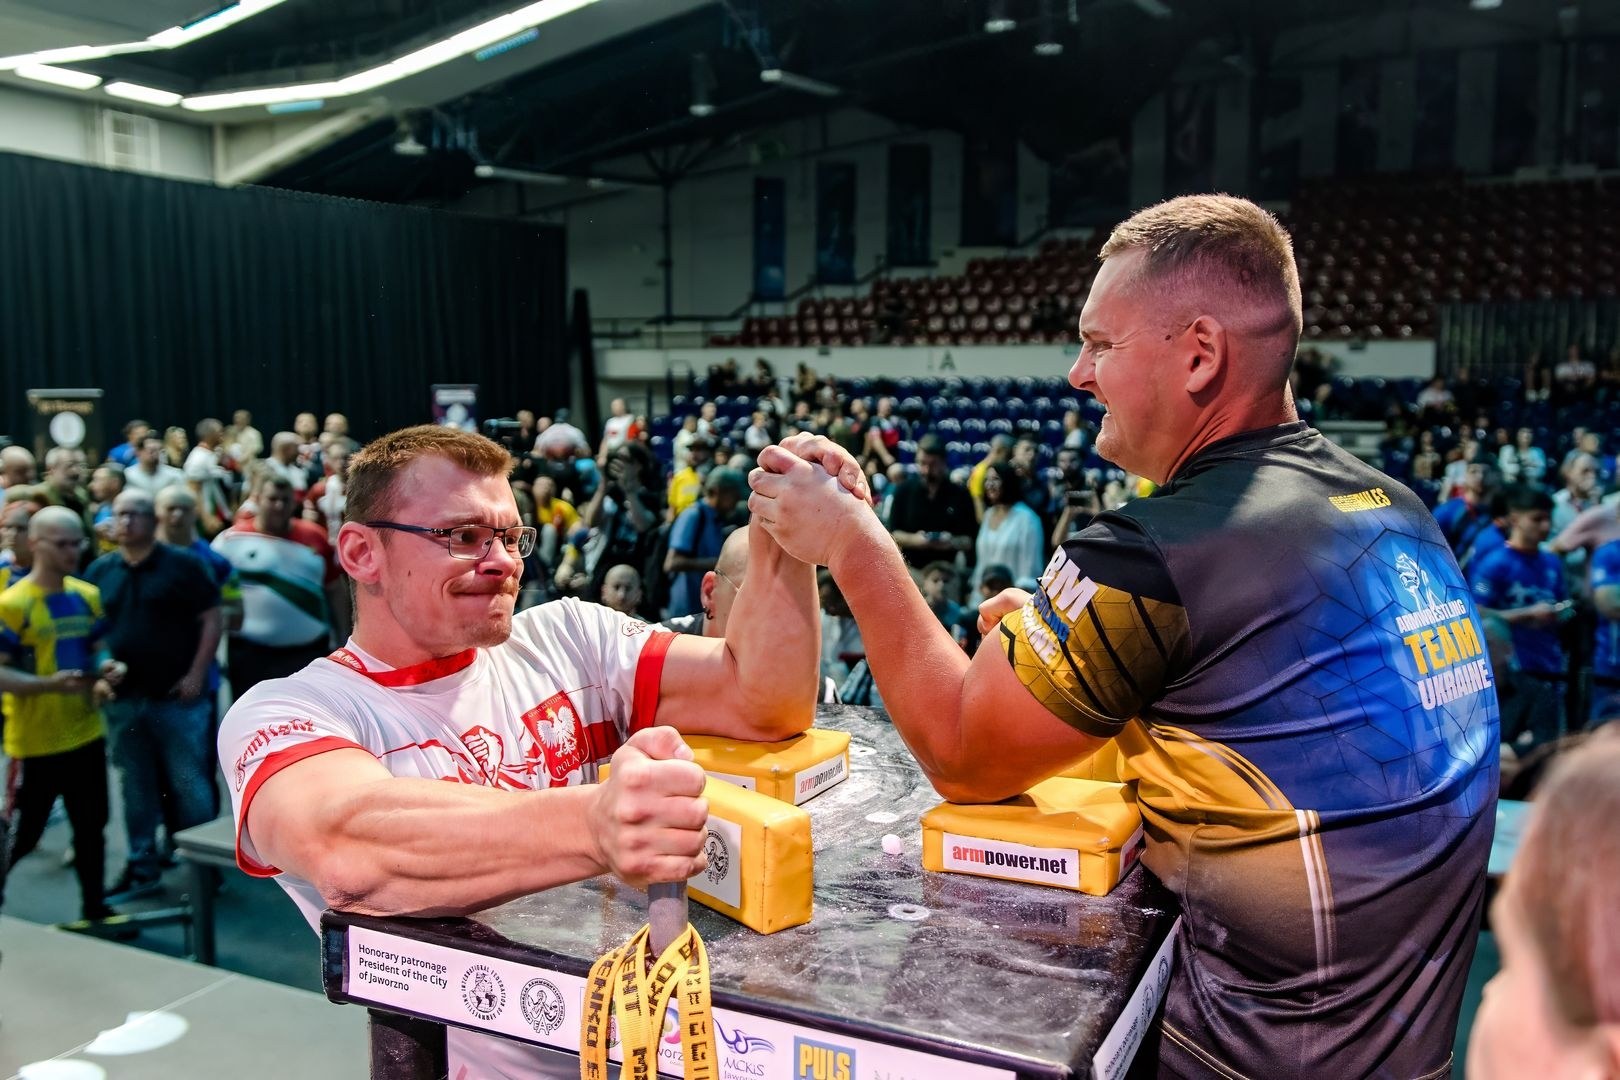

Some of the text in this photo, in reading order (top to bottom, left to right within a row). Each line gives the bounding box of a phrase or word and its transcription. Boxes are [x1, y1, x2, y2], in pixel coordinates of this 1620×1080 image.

[1041, 544, 1100, 623] RM
[1396, 599, 1467, 633] ARMWRESTLING
[1404, 617, 1483, 675] TEAM
[1417, 658, 1492, 710] UKRAINE
[952, 845, 1068, 875] armpower.net
[358, 943, 447, 974] Honorary patronage
[359, 957, 448, 989] President of the City
[359, 970, 410, 992] of Jaworzno
[799, 1043, 850, 1080] PULS
